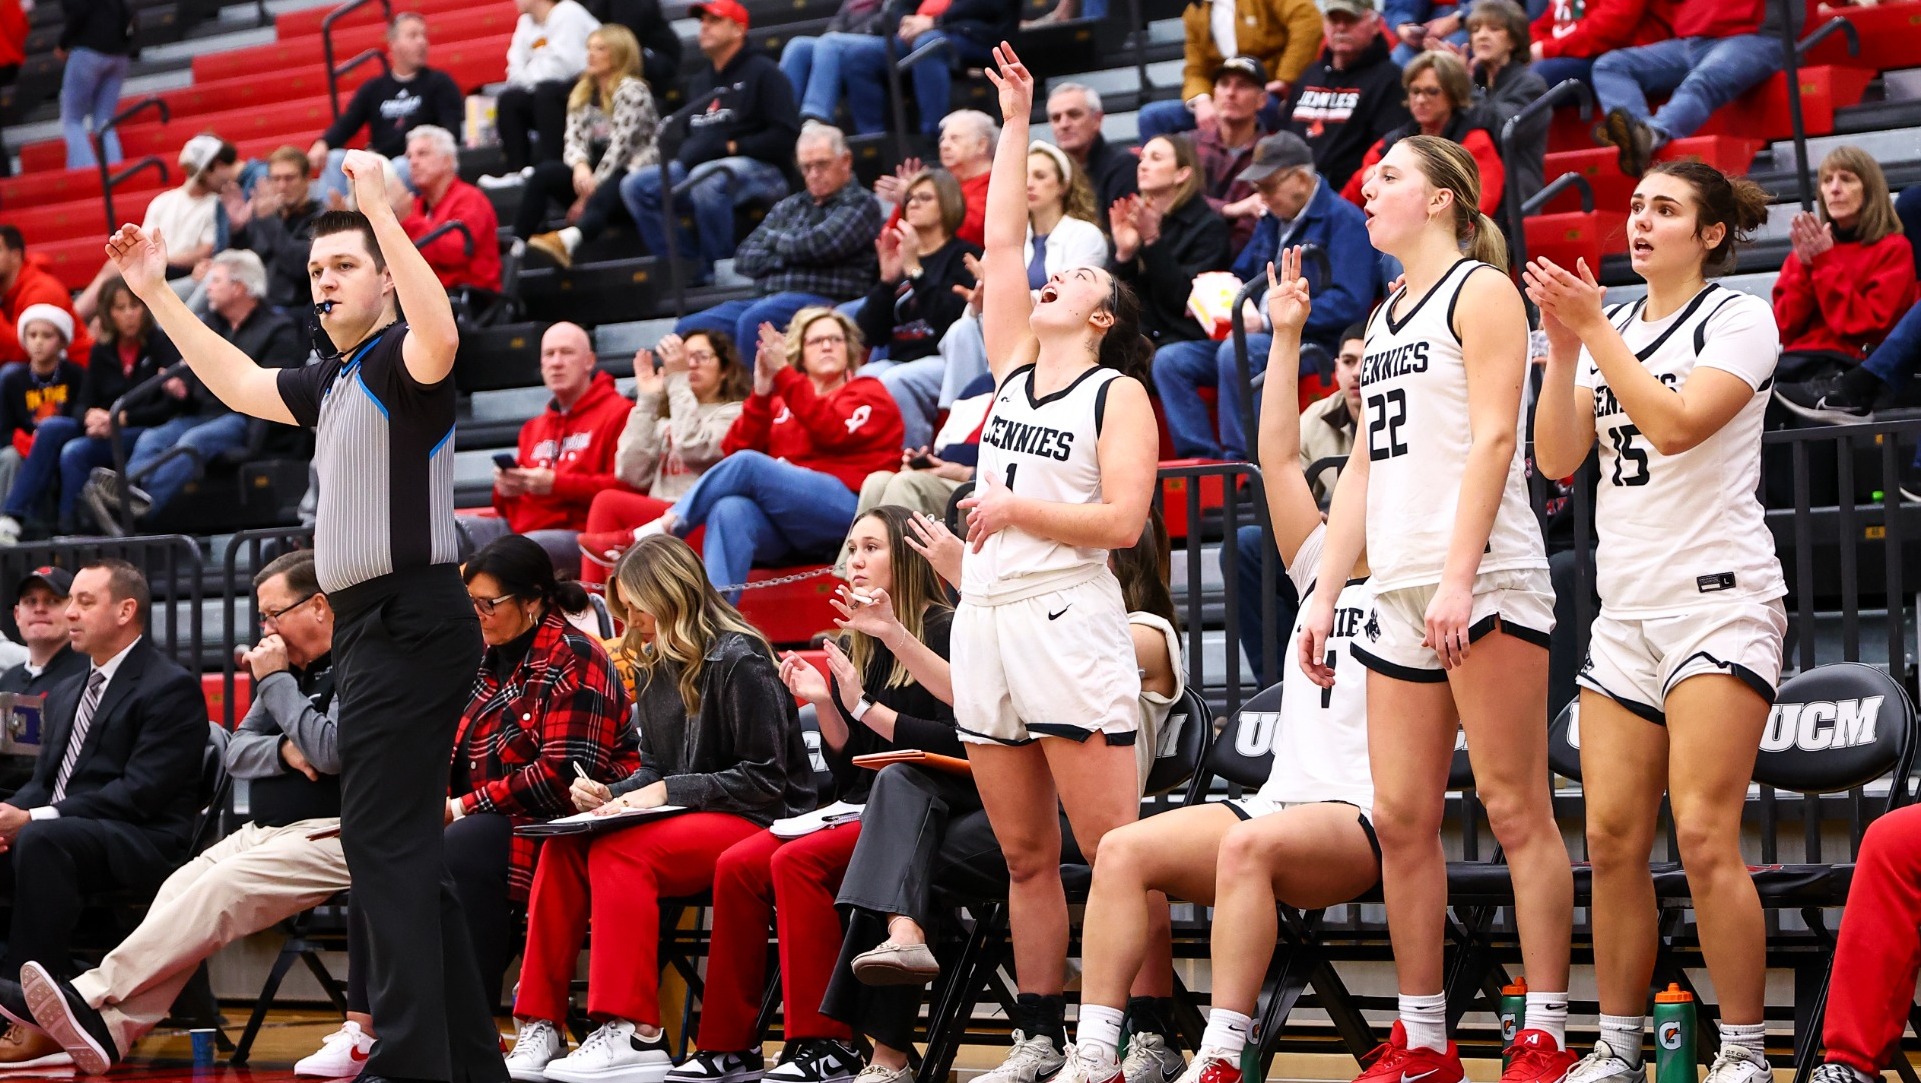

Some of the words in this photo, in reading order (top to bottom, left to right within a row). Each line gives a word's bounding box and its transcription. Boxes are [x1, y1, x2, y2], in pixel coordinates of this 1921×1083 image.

[1361, 341, 1430, 388] ENNIES
[1367, 388, 1408, 462] 22
[1608, 424, 1650, 487] 15
[1005, 463, 1018, 493] 1
[1723, 577, 1730, 585] L
[1759, 695, 1885, 752] UCM
[1500, 1013, 1517, 1041] G
[1659, 1021, 1682, 1050] G
